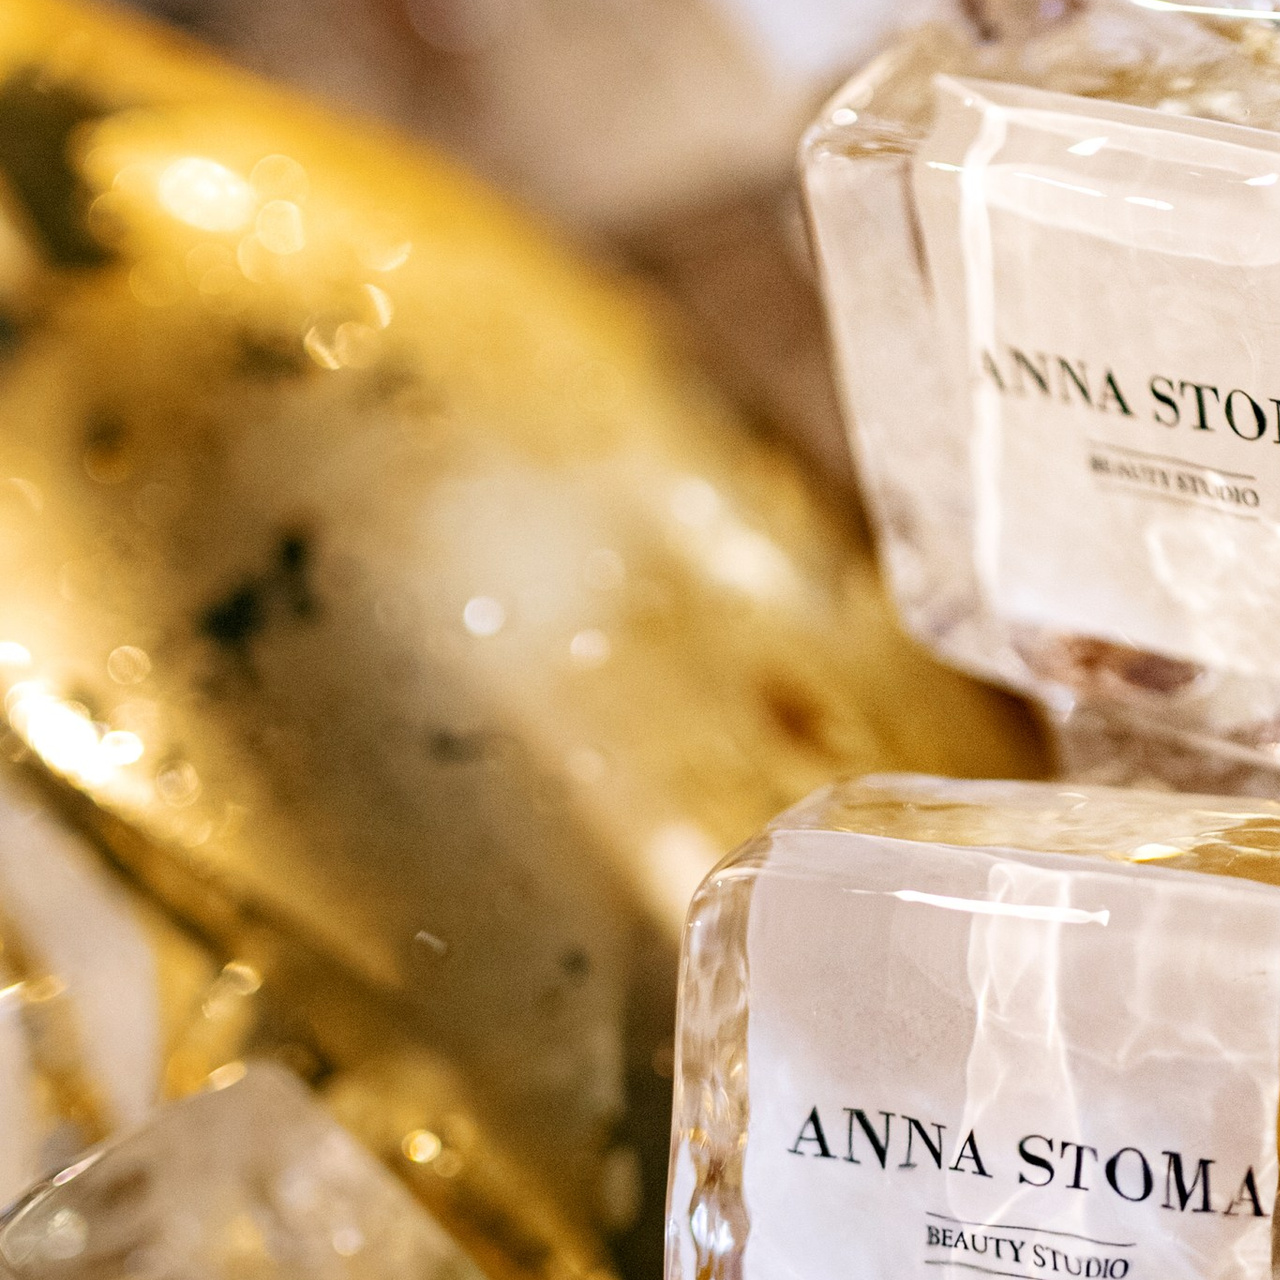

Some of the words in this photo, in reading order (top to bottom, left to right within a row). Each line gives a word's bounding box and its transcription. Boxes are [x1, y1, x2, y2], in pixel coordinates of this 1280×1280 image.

[788, 1104, 992, 1179] ANNA
[1018, 1134, 1270, 1218] STOMA
[926, 1225, 1026, 1263] BEAUTY
[1032, 1243, 1130, 1280] STUDIO
